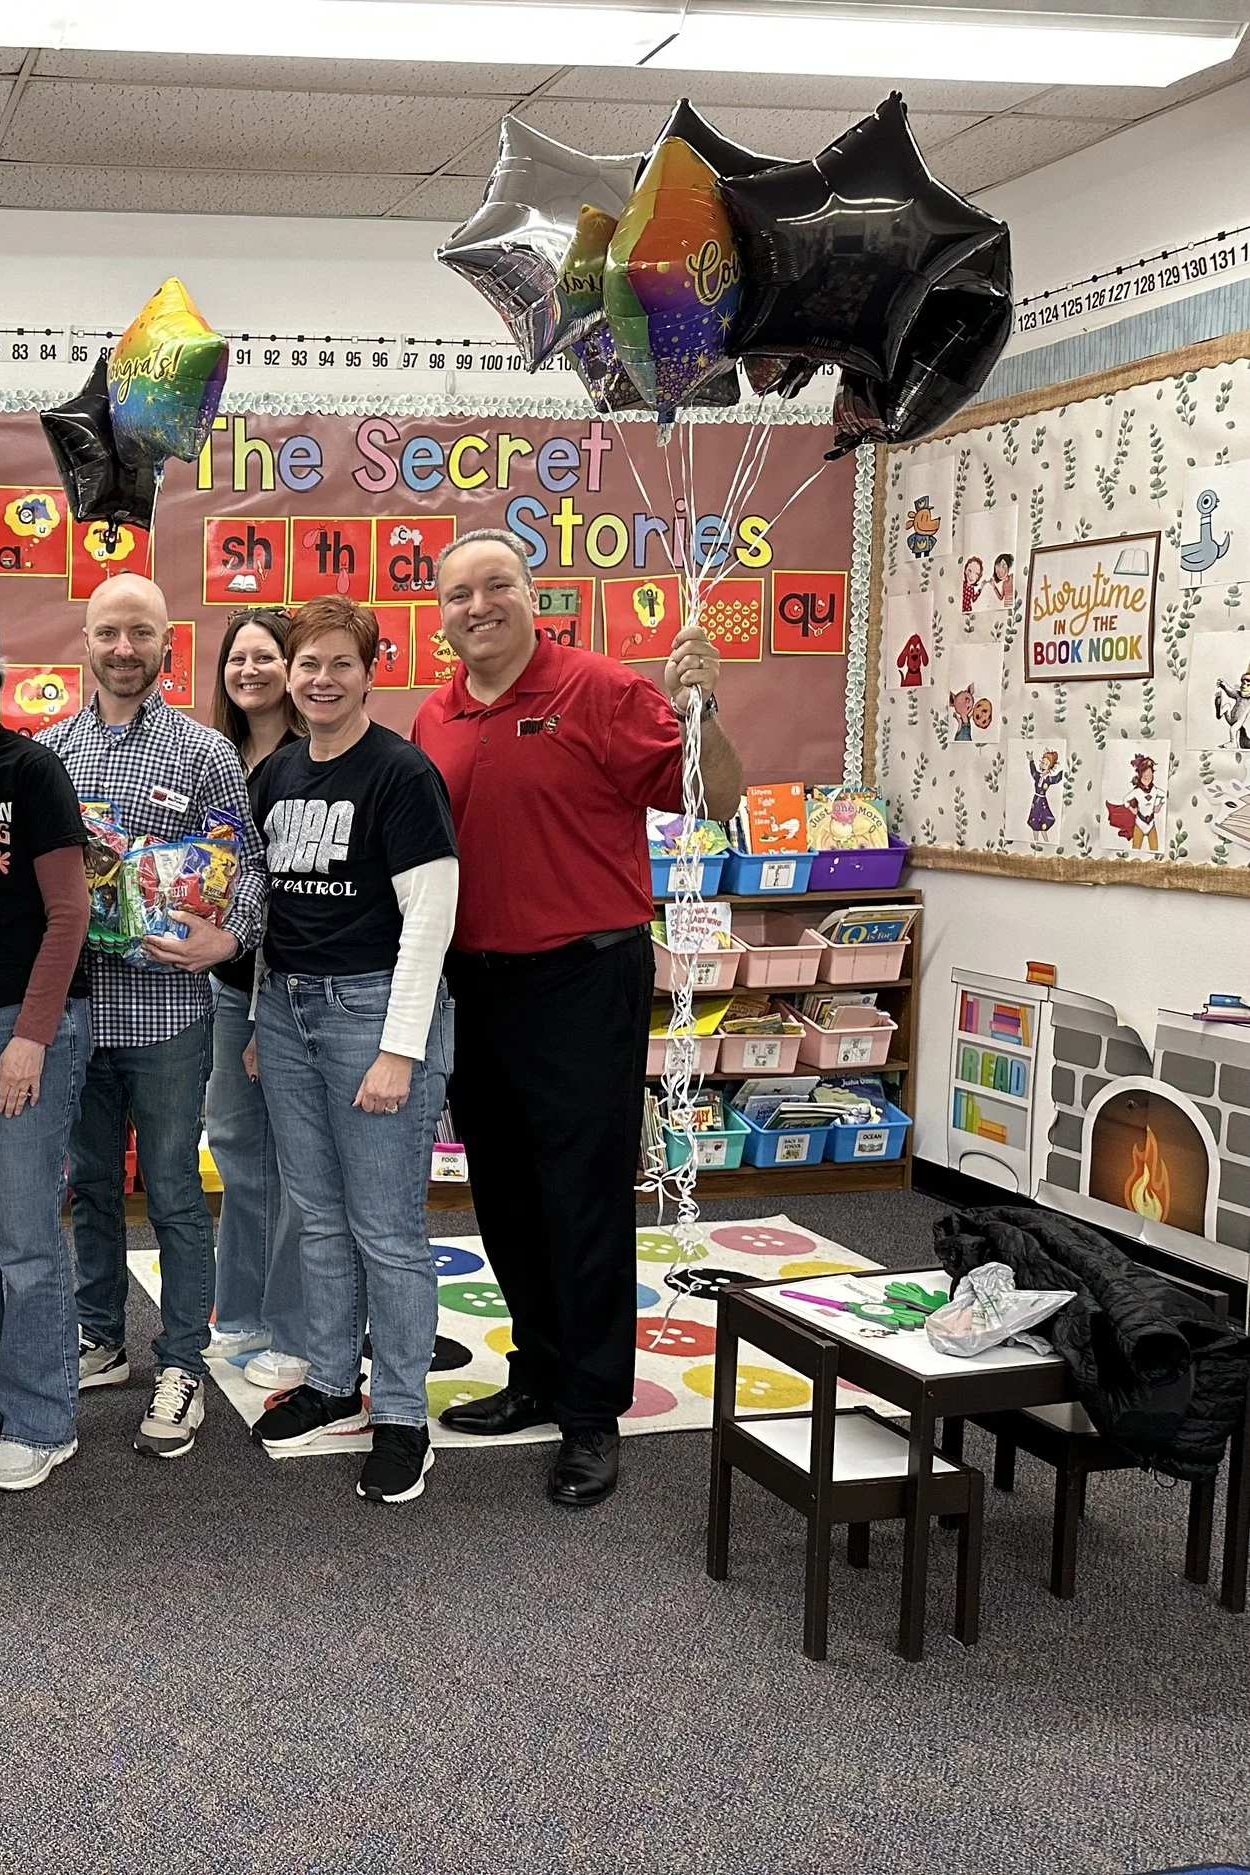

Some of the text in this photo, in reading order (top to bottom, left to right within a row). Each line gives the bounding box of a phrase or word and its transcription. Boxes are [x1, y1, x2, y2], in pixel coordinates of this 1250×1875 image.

[1018, 311, 1037, 332] 123
[1038, 304, 1059, 325] 124
[1061, 296, 1083, 318] 125
[1085, 288, 1106, 311] 126
[1108, 280, 1132, 302] 127
[1133, 273, 1156, 296] 128
[1157, 265, 1181, 288] 129
[1181, 256, 1208, 280] 130
[1210, 246, 1236, 272] 131
[11, 343, 29, 360] 83
[40, 343, 57, 361] 84
[71, 345, 88, 362] 85
[236, 349, 251, 365] 91
[263, 349, 281, 366] 92
[291, 350, 308, 366] 93
[318, 350, 335, 367] 94
[345, 351, 362, 367] 95
[372, 351, 389, 368] 96
[402, 352, 419, 368] 97
[429, 353, 445, 369] 98
[456, 354, 473, 370] 99
[480, 354, 503, 371] 100
[196, 416, 614, 494] The Secret
[221, 525, 273, 571] sh
[314, 530, 356, 574] th
[505, 495, 774, 569] Stories
[388, 544, 436, 584] ch
[778, 592, 836, 638] qu
[1033, 561, 1147, 637] storytime
[1053, 615, 1118, 635] IN THE
[1033, 635, 1143, 666] BOOK NOOK
[809, 807, 831, 829] Just
[857, 806, 883, 828] More
[283, 880, 358, 897] PATROL
[961, 1046, 1028, 1098] READ
